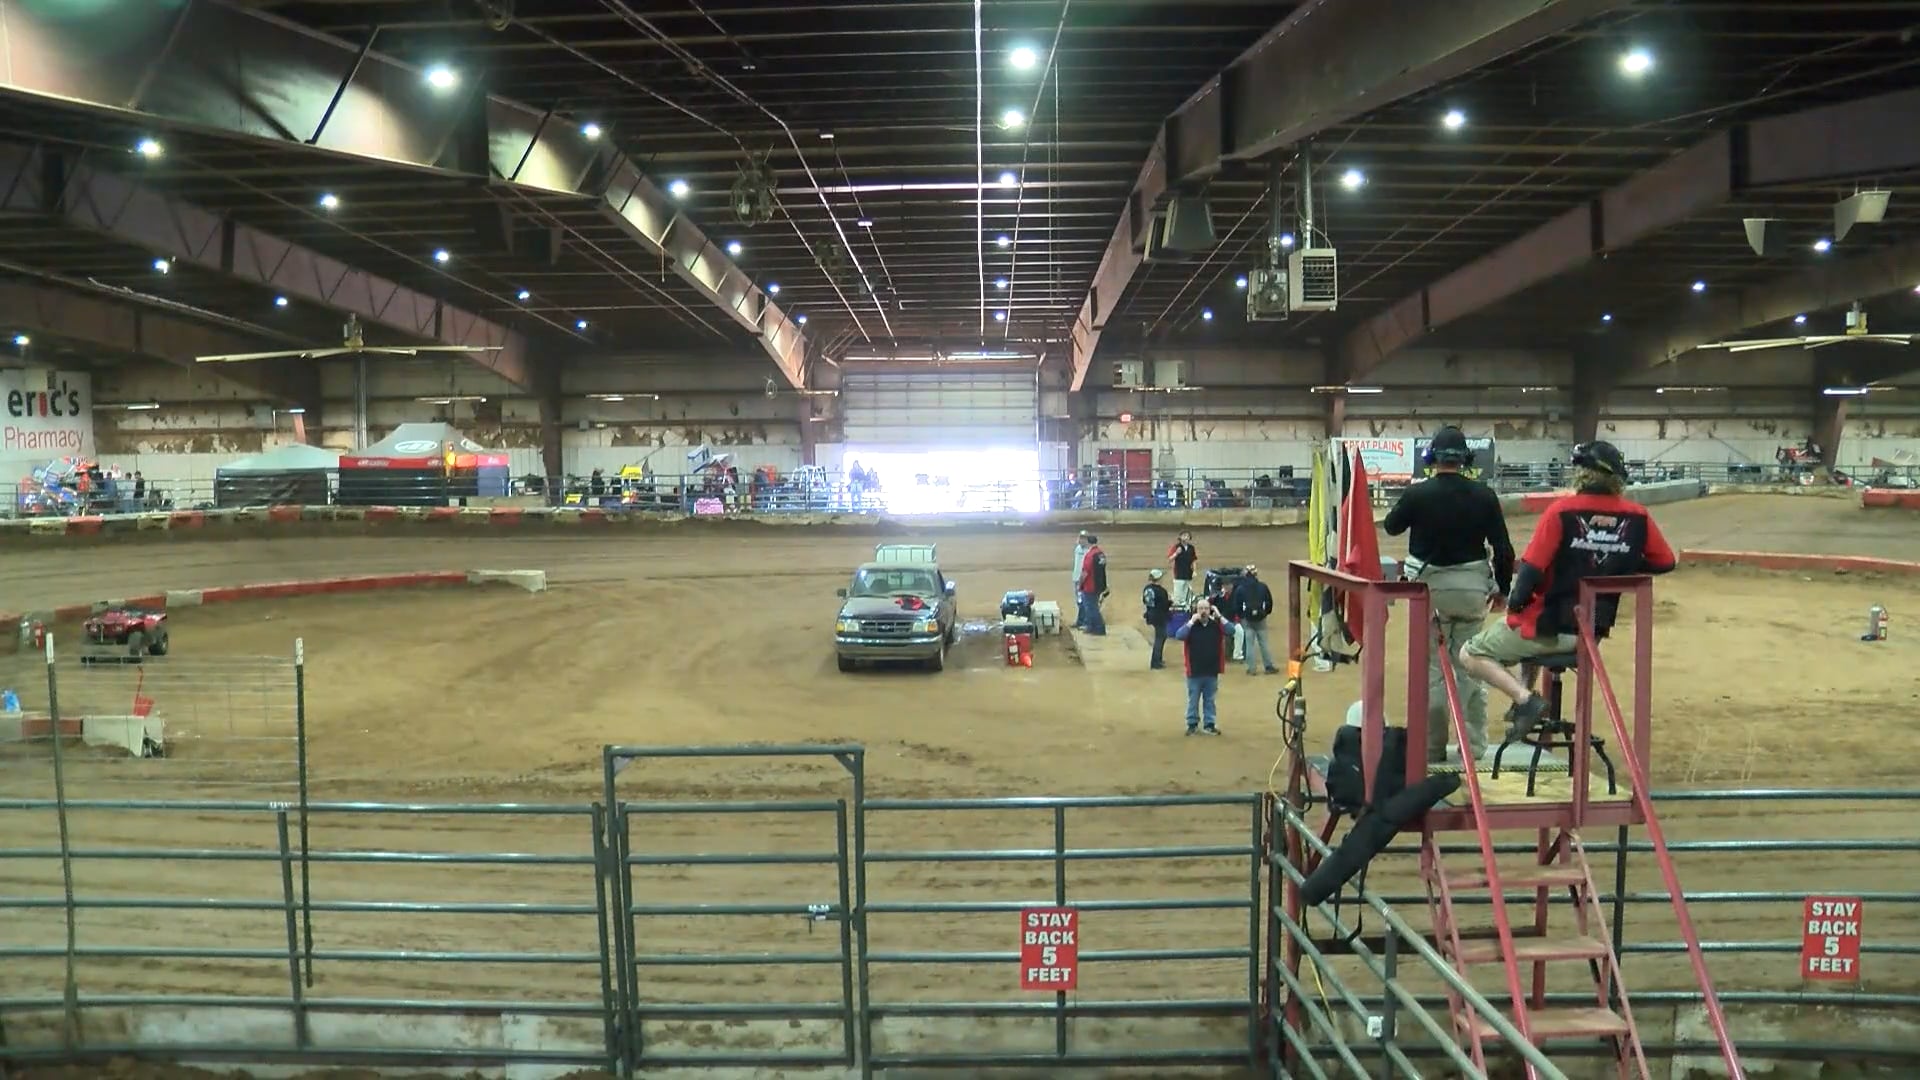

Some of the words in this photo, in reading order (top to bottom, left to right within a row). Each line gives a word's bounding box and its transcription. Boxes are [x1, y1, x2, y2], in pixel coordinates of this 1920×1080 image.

[7, 380, 80, 417] eric's
[5, 426, 84, 452] Pharmacy
[1372, 440, 1404, 457] PLAINS
[1812, 902, 1856, 916] STAY
[1028, 913, 1072, 927] STAY
[1808, 920, 1858, 936] BACK
[1025, 931, 1074, 945] BACK
[1824, 936, 1840, 956] 5
[1042, 946, 1057, 966] 5
[1809, 957, 1853, 973] FEET
[1028, 968, 1072, 982] FEET
